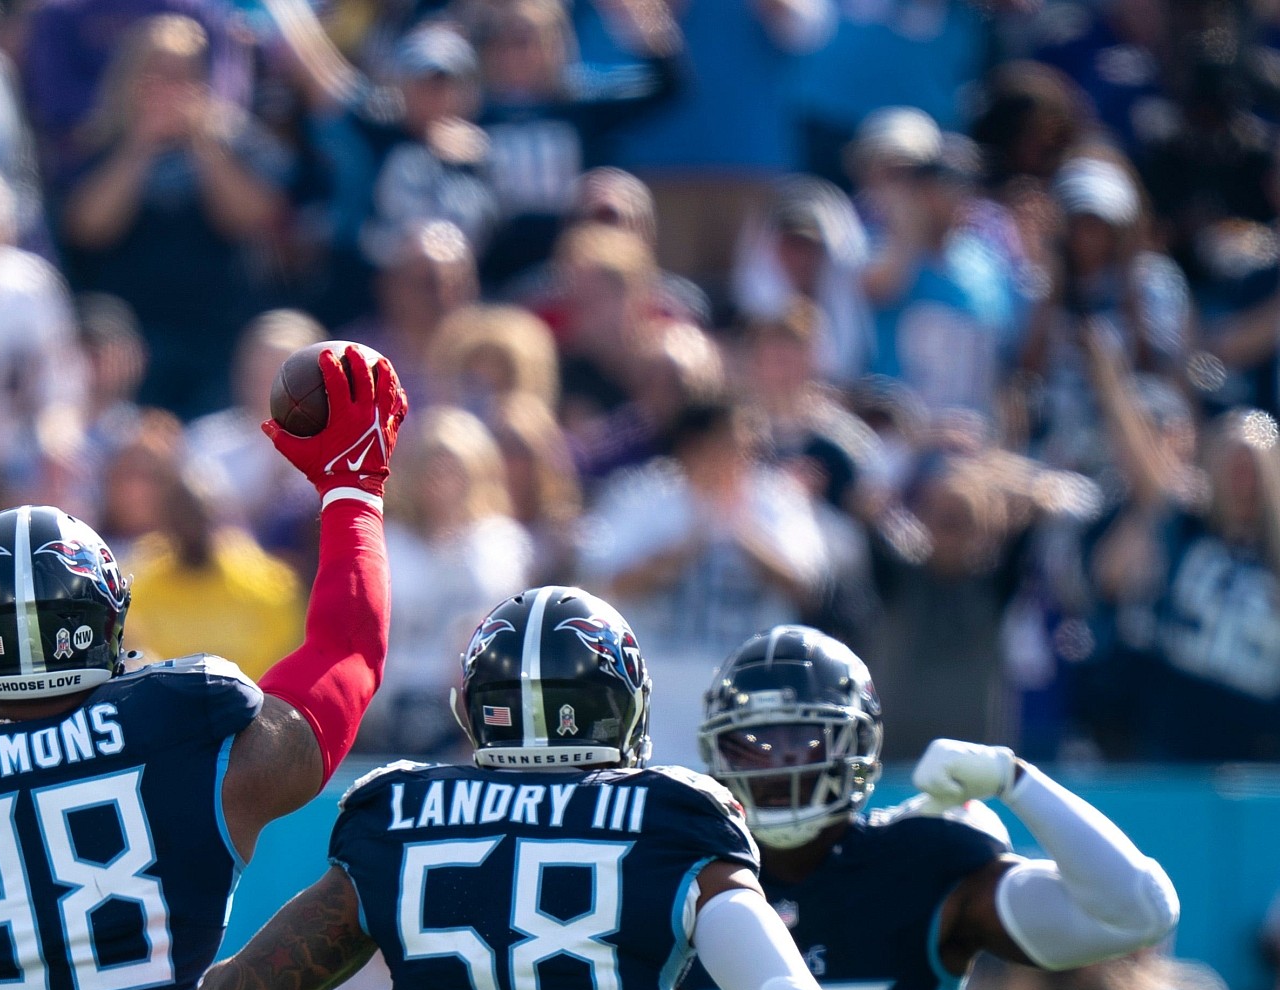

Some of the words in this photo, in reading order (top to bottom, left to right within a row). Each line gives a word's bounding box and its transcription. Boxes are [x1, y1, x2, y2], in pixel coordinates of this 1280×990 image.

[75, 630, 91, 645] NW
[49, 675, 81, 689] LOVE
[489, 752, 593, 764] TENNESSEE
[388, 780, 579, 831] LANDRY
[592, 783, 648, 833] III
